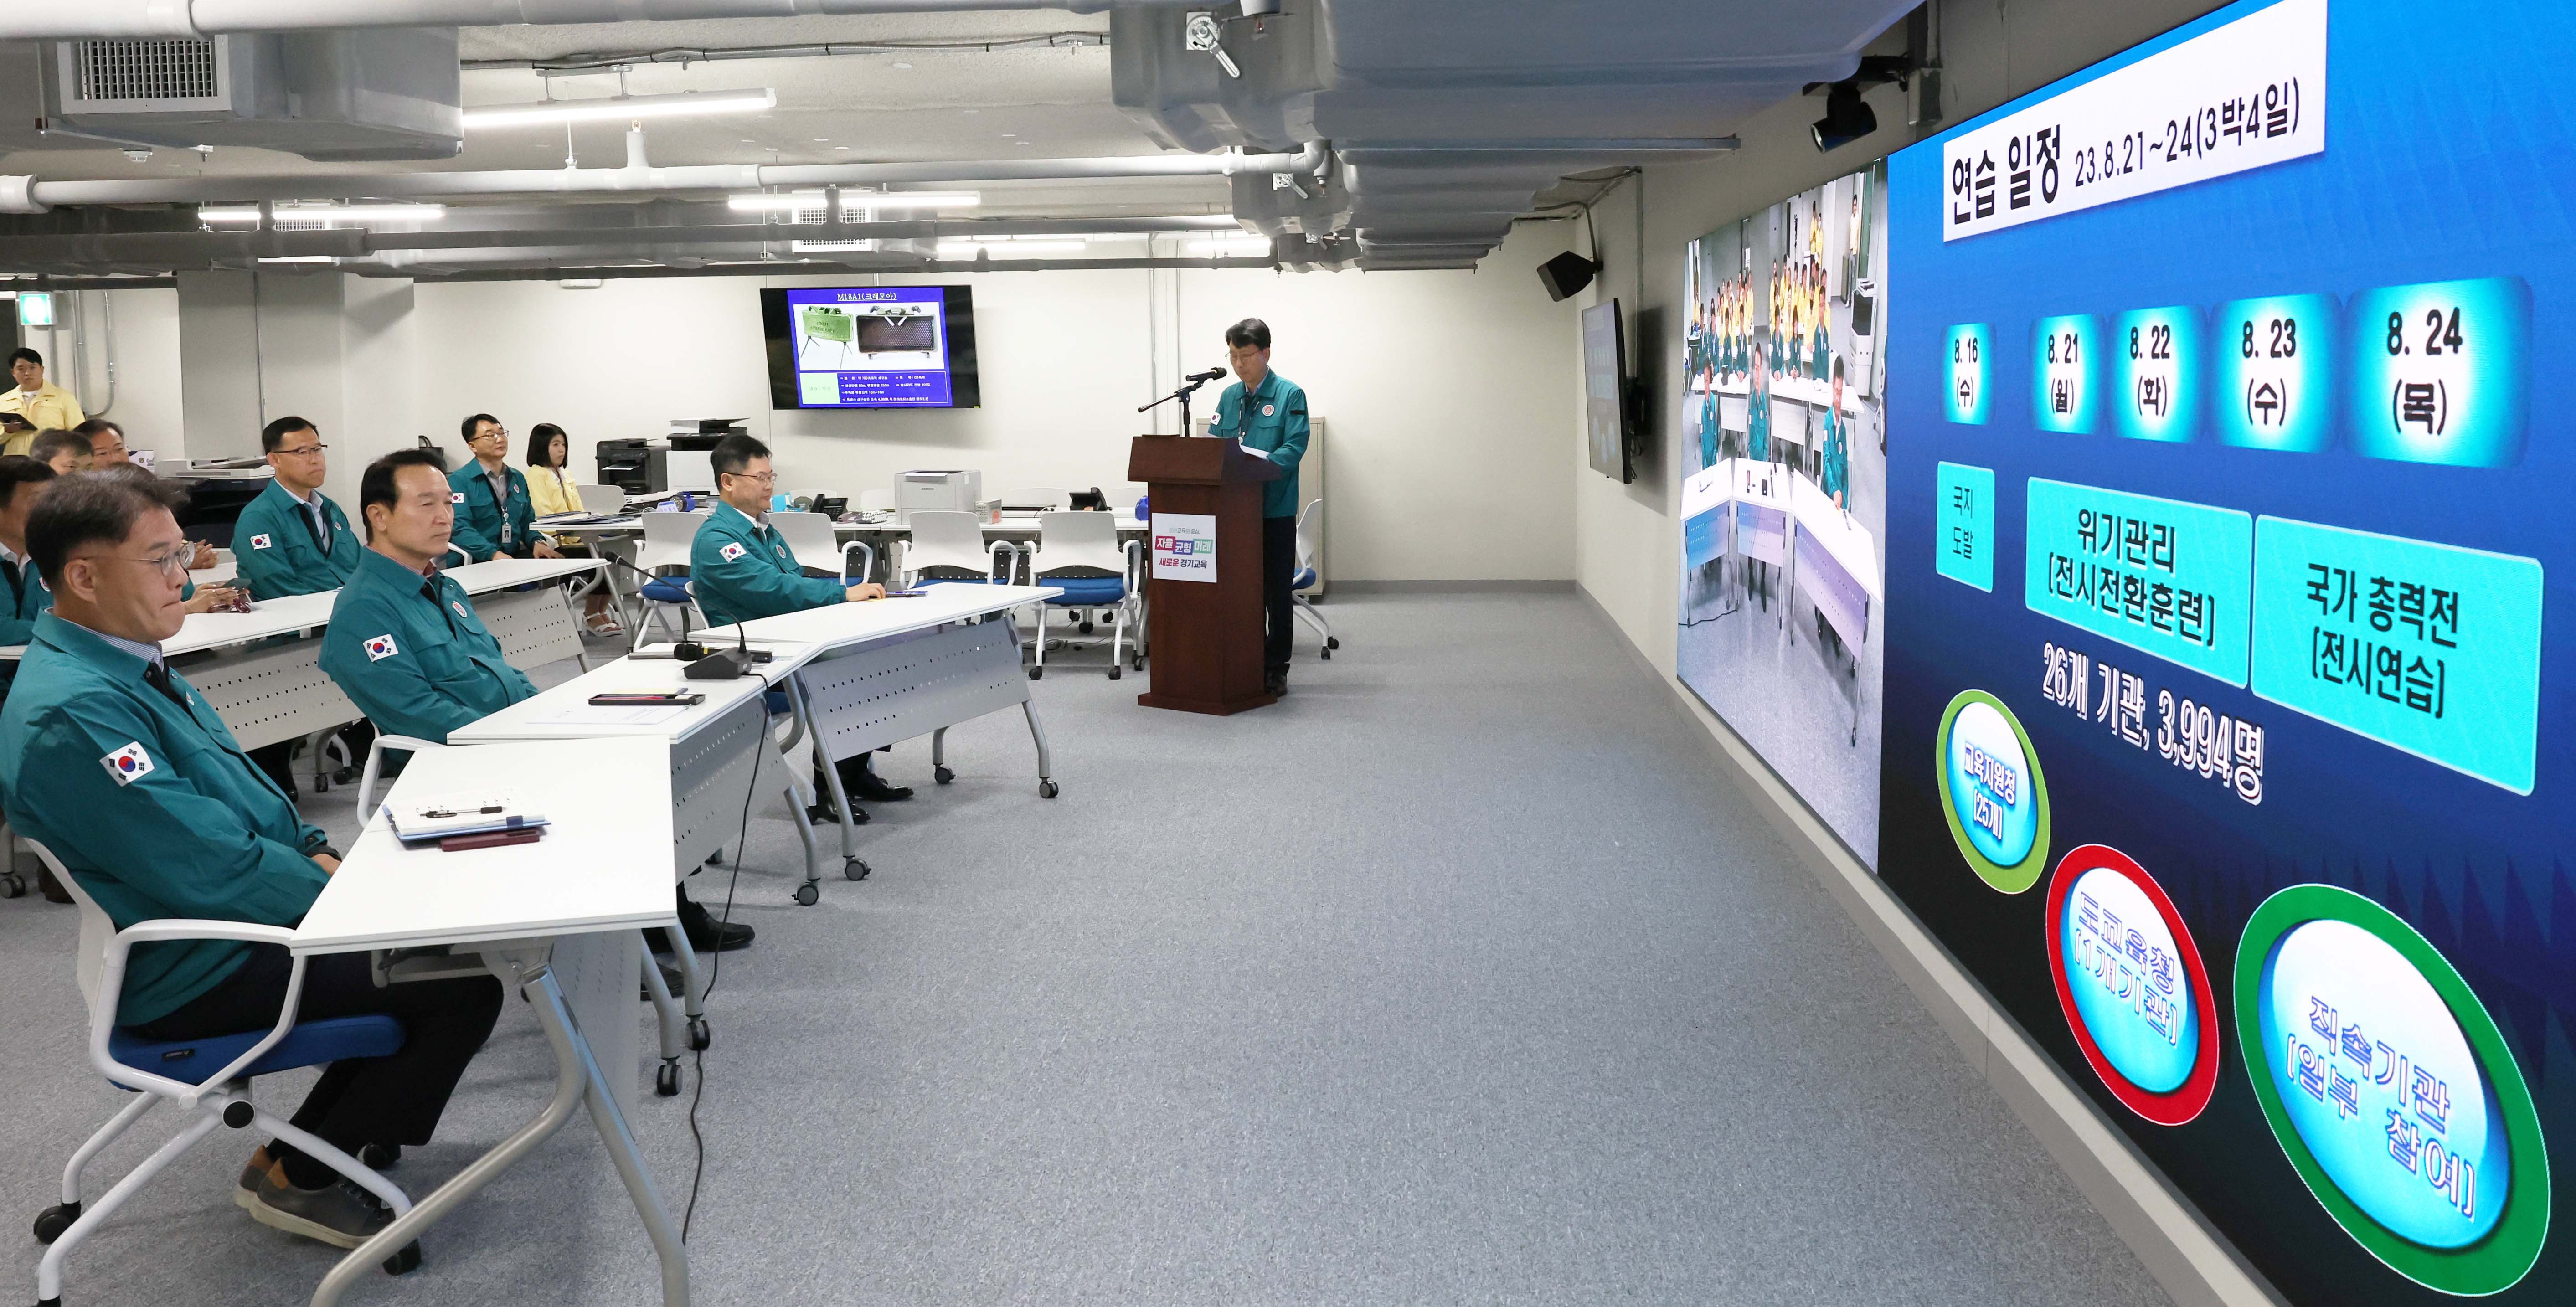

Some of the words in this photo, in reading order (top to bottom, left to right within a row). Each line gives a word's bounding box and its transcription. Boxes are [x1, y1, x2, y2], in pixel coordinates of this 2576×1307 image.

[1953, 149, 1995, 225] 연습
[2009, 124, 2060, 210] 일정
[2075, 76, 2299, 187] 23.8.21~24(3박4일)
[837, 292, 897, 301] M18A1(크레모아)
[1967, 337, 1978, 363] 16
[2065, 333, 2078, 364] 21
[2151, 325, 2170, 359] 22
[2270, 318, 2296, 358] 23
[2426, 307, 2463, 355] 24
[1957, 376, 1973, 407] (수)
[2051, 378, 2074, 415] (월)
[2138, 375, 2167, 417] (화)
[2247, 378, 2286, 427] (수)
[2393, 379, 2447, 436] (목)
[1954, 486, 1973, 519] 국지
[1157, 537, 1174, 548] 자율
[1175, 542, 1192, 553] 균형
[1195, 540, 1211, 551] 미래
[1953, 526, 1973, 559] 도발
[2078, 509, 2175, 574] 위기관리
[1159, 557, 1179, 566] 새로운
[1180, 559, 1207, 569] 경기교육
[2307, 562, 2358, 623] 국가
[2368, 576, 2458, 649] 총력전
[2042, 641, 2089, 720] 26개
[2097, 663, 2149, 751] 기관,
[2158, 690, 2264, 805] 3,994명
[1964, 742, 2016, 805] 교육지원청
[2079, 891, 2174, 995] 도교육청
[2309, 995, 2450, 1134] 직속기관
